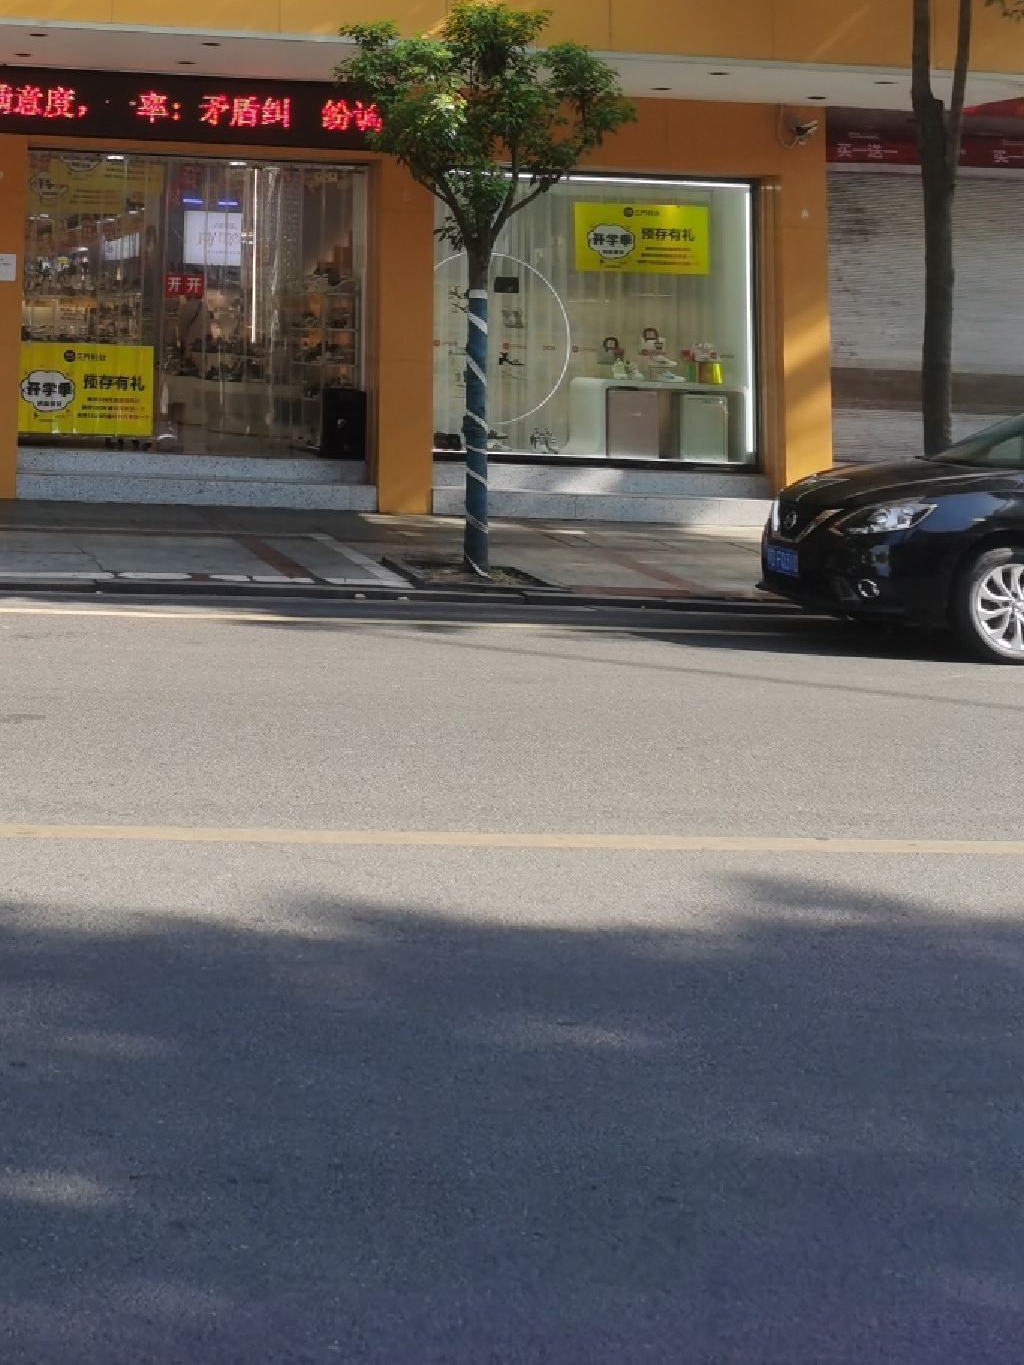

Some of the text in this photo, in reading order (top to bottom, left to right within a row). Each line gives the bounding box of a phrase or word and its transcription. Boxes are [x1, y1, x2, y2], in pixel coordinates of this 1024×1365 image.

[837, 143, 899, 158] 买一送一
[27, 381, 73, 397] 开学季
[83, 373, 145, 392] 预存有礼
